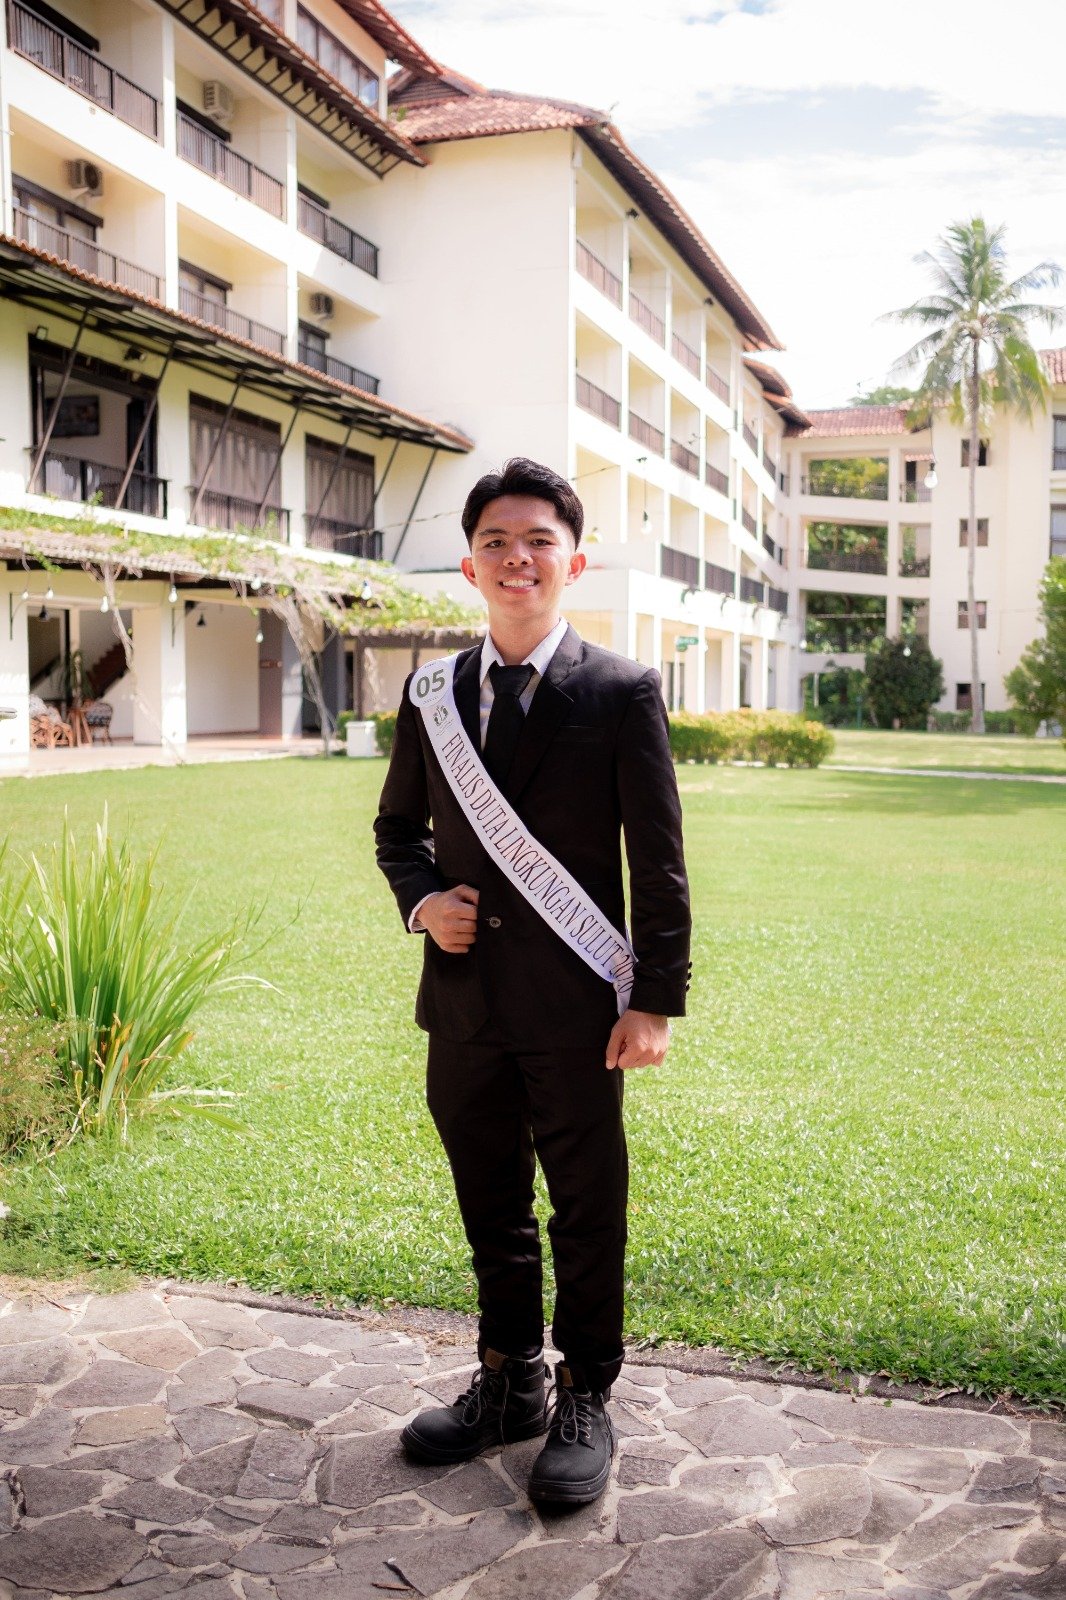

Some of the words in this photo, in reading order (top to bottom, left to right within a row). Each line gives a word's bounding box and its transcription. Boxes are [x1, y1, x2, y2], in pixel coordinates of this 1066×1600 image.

[416, 669, 446, 699] 05
[442, 732, 485, 799] FINALIS
[470, 788, 511, 841] DUTA
[493, 826, 587, 929] LINGKUNGAN
[569, 914, 625, 968] SULUT
